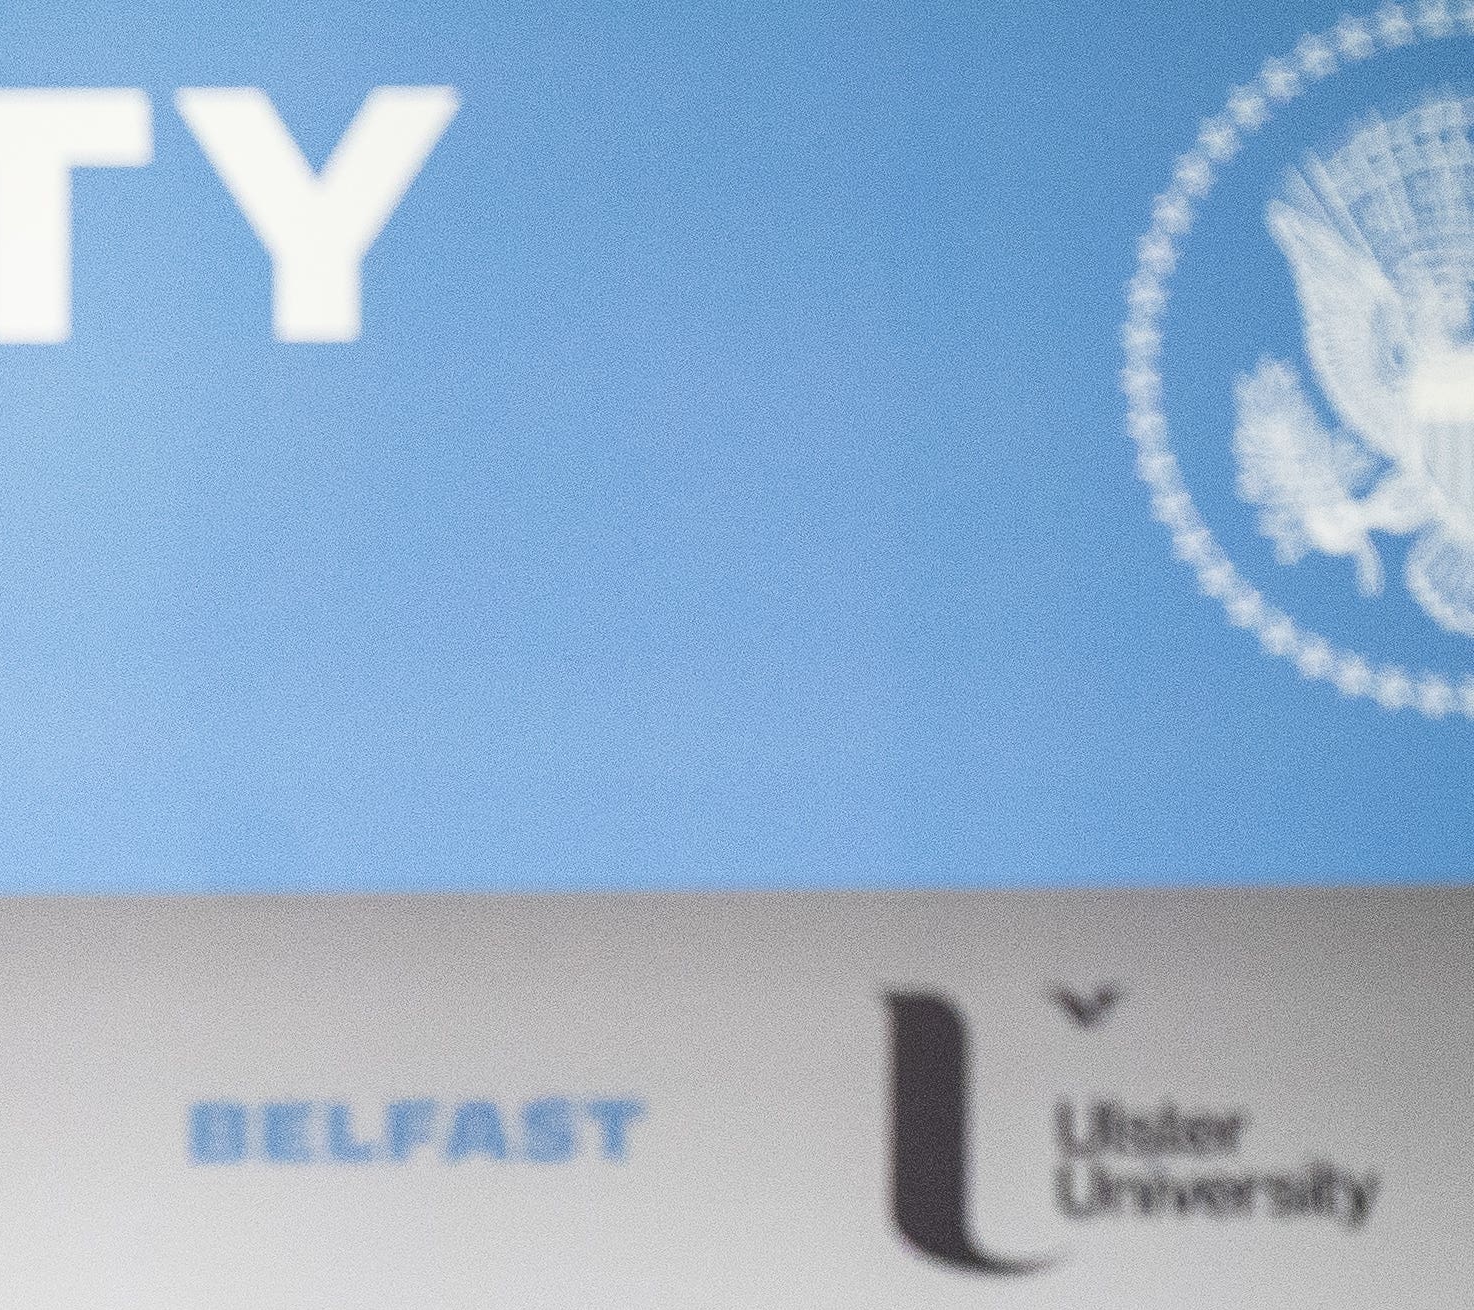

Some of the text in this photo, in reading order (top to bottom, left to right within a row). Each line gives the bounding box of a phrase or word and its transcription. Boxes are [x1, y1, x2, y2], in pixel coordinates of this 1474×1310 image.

[185, 1094, 644, 1166] BELFAST
[1058, 1100, 1244, 1154] Ulster
[1059, 1162, 1376, 1225] University
